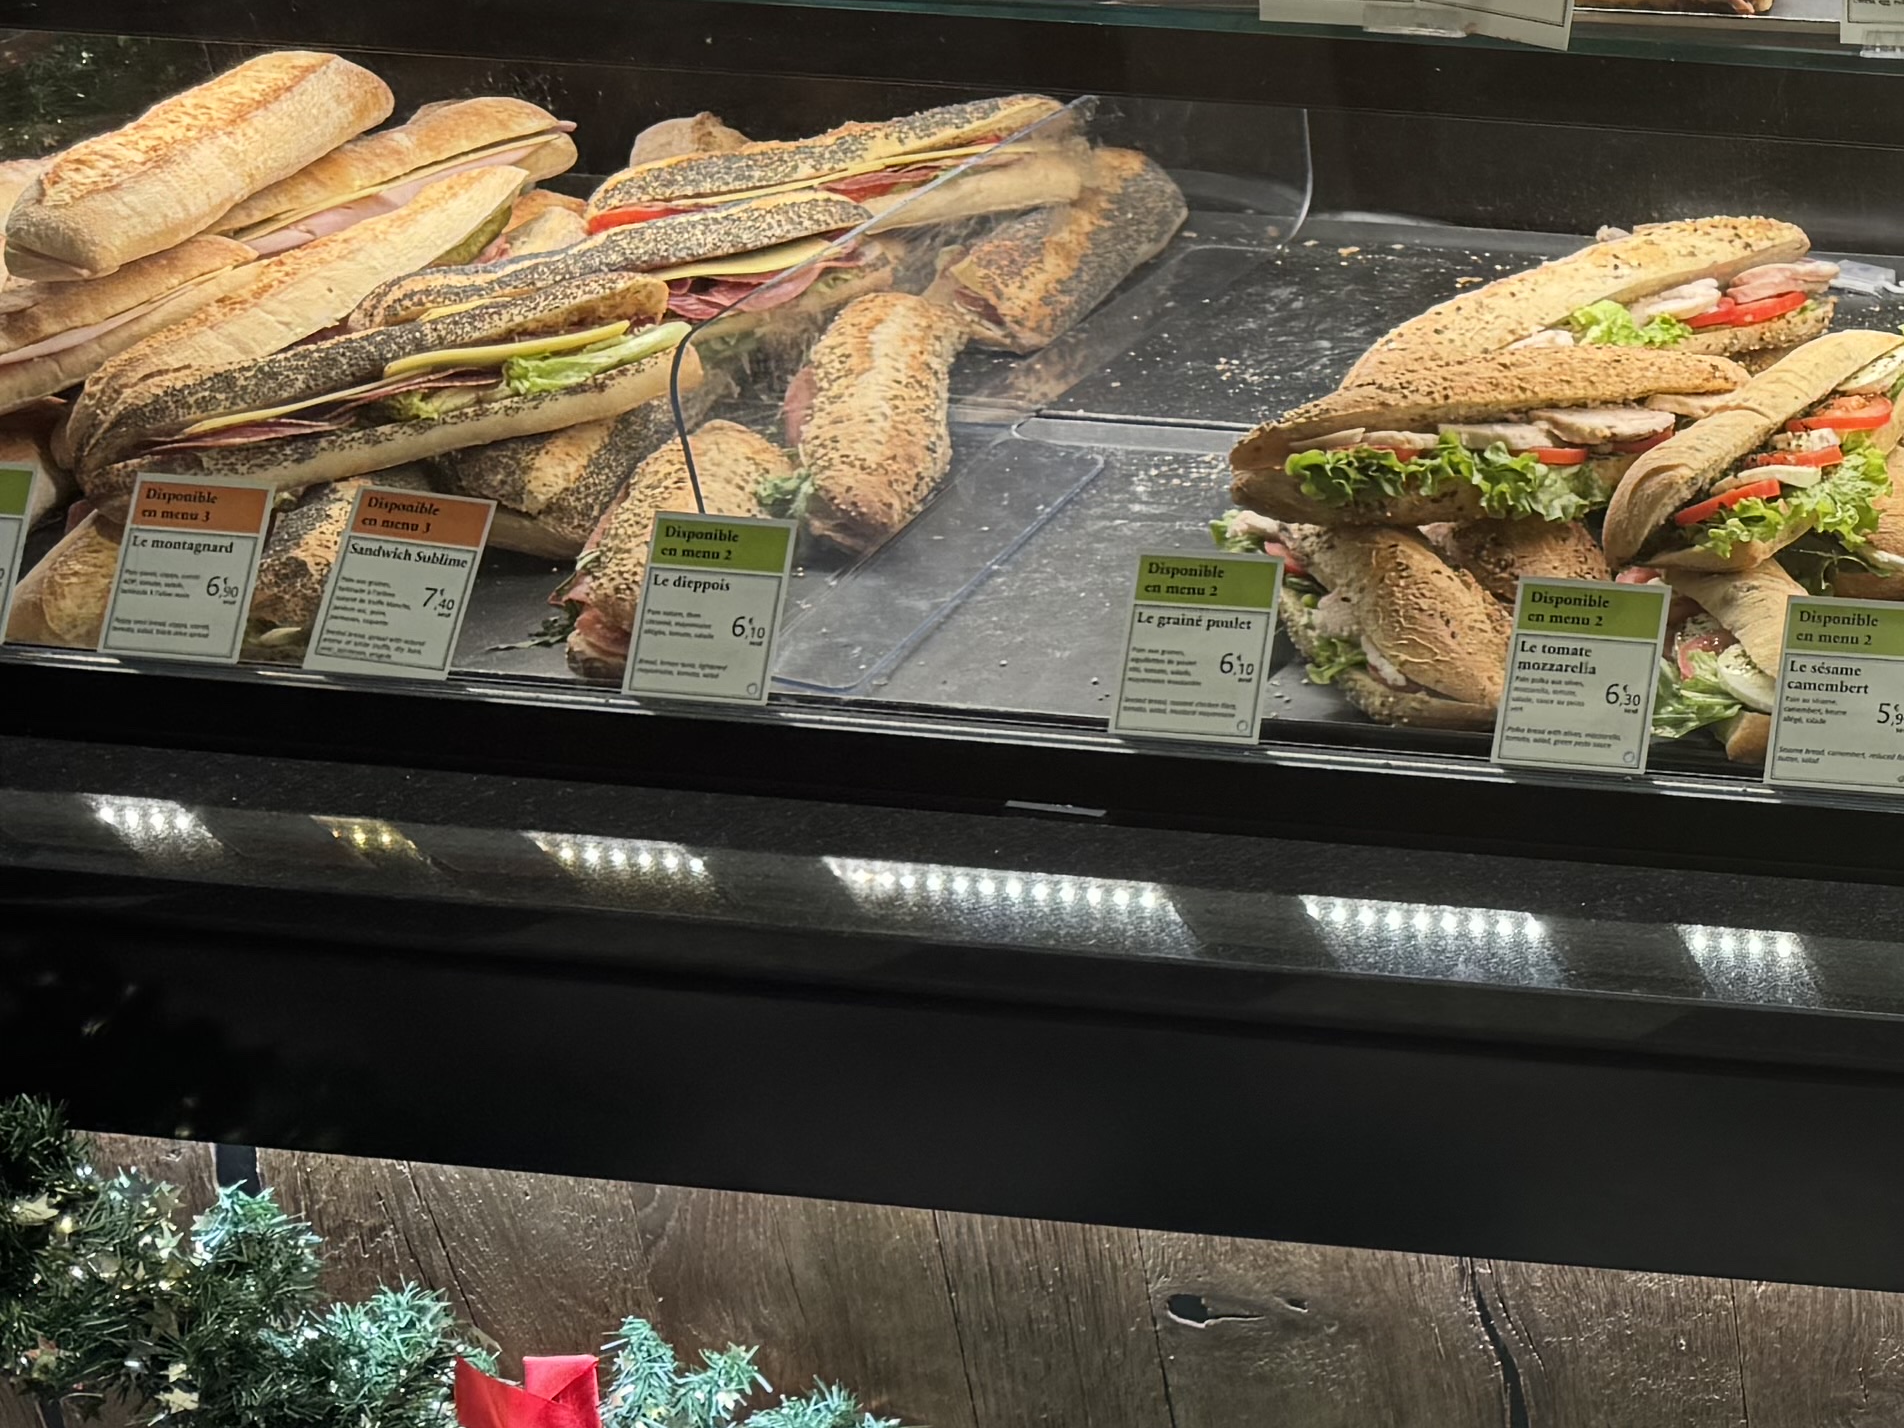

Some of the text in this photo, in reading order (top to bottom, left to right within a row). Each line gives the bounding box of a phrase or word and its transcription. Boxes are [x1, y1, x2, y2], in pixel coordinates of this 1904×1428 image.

[130, 534, 235, 556] Le montagnard
[349, 541, 468, 569] Sandwich Sublime
[652, 572, 730, 594] Le dieppois
[1519, 639, 1592, 658] Le tomate
[1516, 659, 1597, 675] mozzarella
